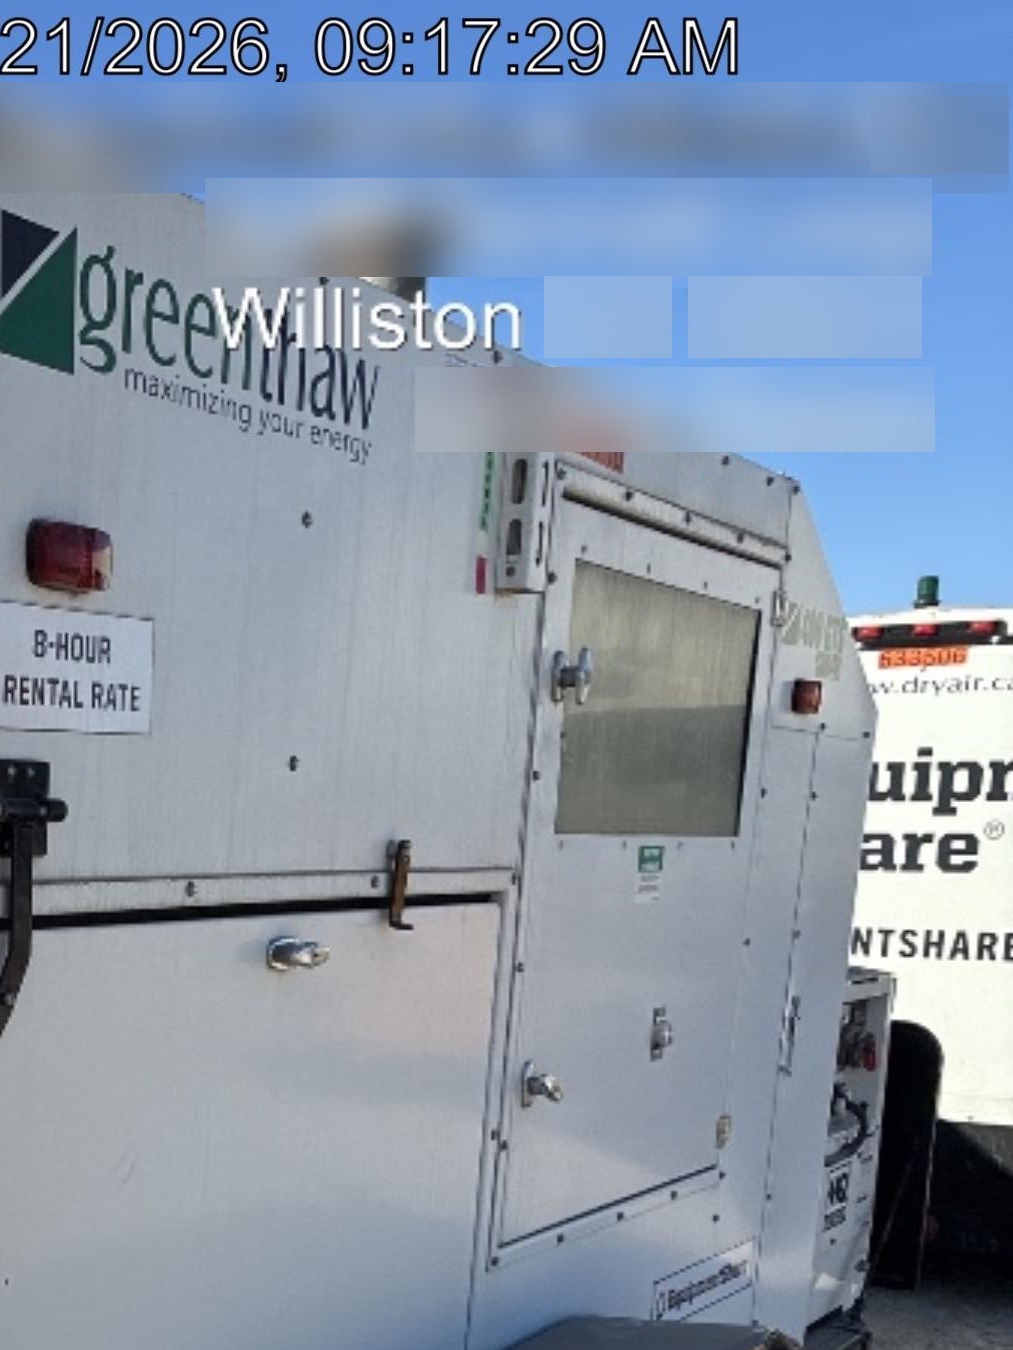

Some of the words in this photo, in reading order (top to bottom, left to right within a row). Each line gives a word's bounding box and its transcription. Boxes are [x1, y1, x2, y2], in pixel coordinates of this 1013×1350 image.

[78, 245, 380, 430] greenthaw
[124, 367, 252, 432] maximizing
[258, 408, 304, 436] your
[310, 424, 372, 466] energy
[33, 628, 112, 665] 8-HOUR
[2, 674, 84, 709] RENTAL
[91, 681, 141, 712] RATE
